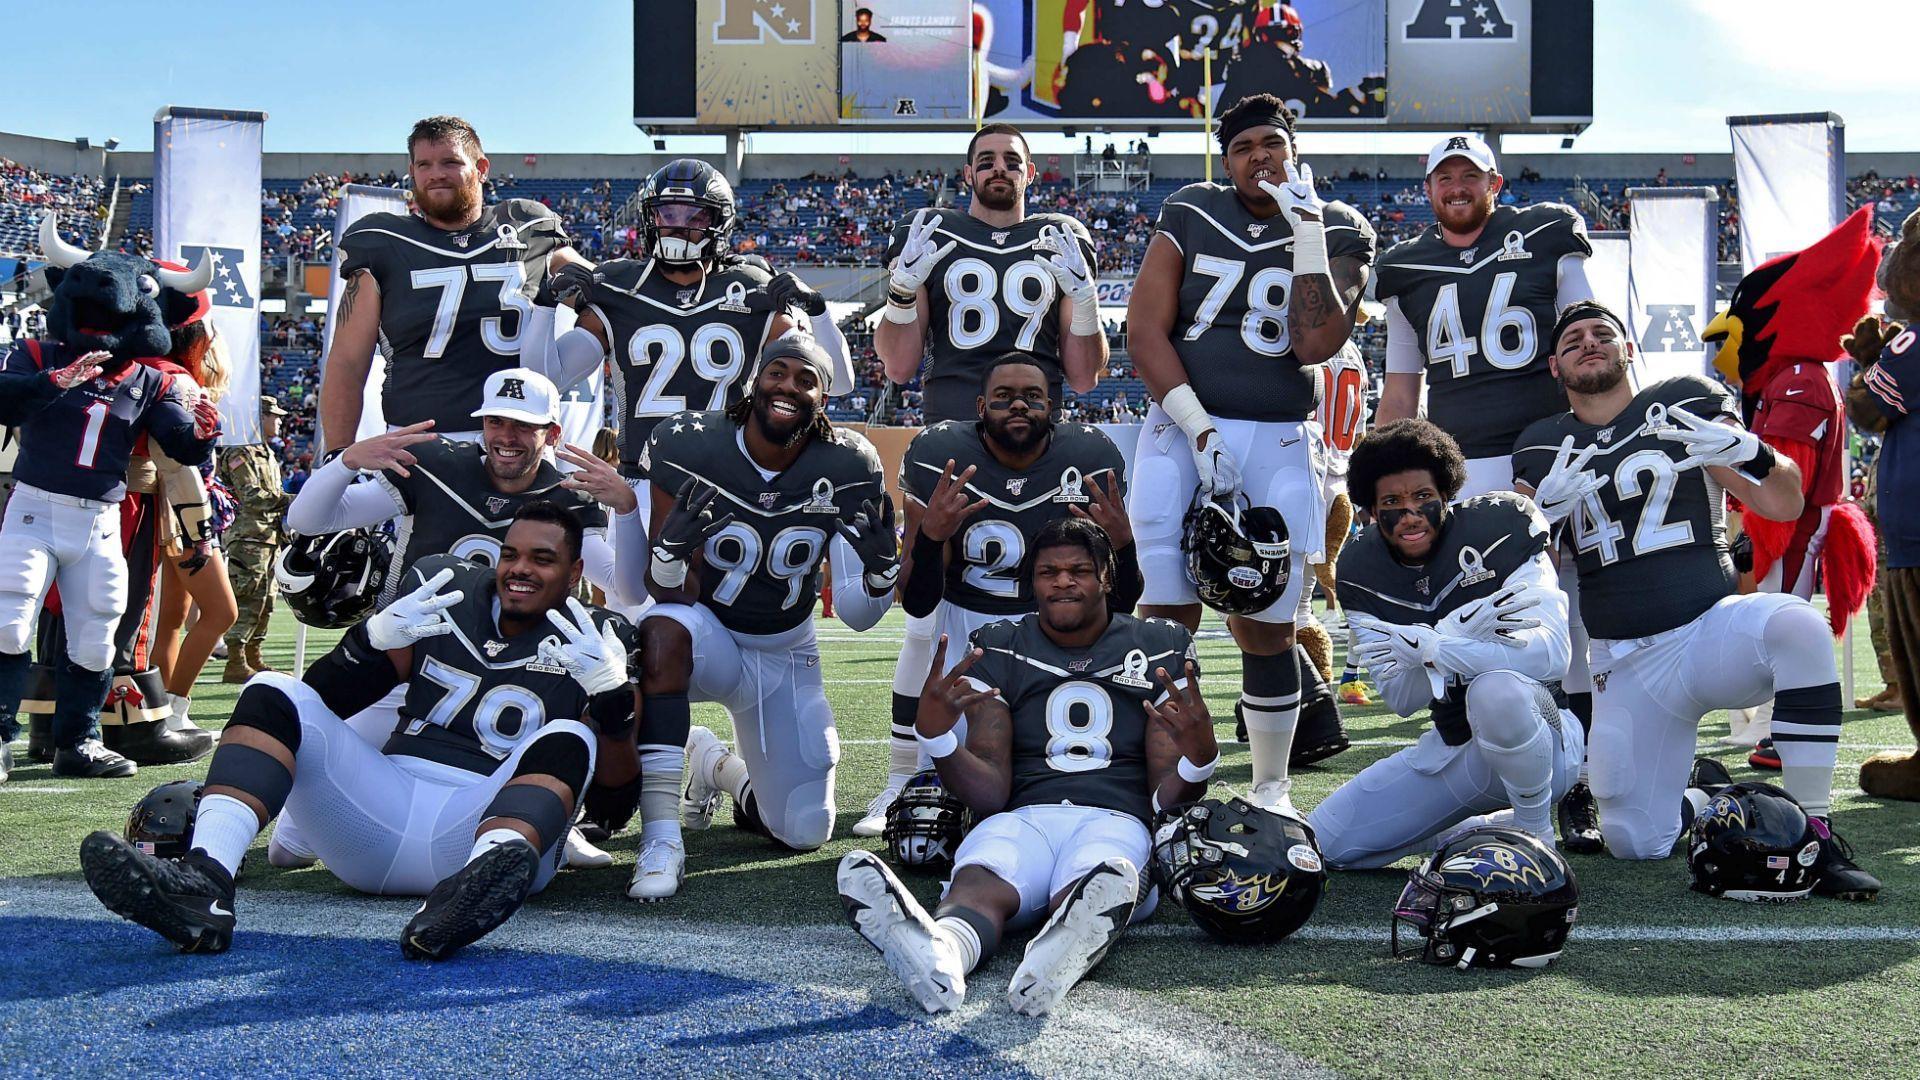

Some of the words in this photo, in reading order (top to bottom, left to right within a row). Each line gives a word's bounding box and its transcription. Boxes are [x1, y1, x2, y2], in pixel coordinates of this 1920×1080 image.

[410, 260, 536, 358] 73
[943, 257, 1057, 351] 89
[1182, 253, 1295, 357] 78
[1426, 271, 1539, 379] 46
[628, 322, 746, 419] 29
[74, 399, 111, 470] 1
[1569, 449, 1697, 567] 42
[703, 520, 828, 611] 99
[1045, 680, 1114, 773] 8
